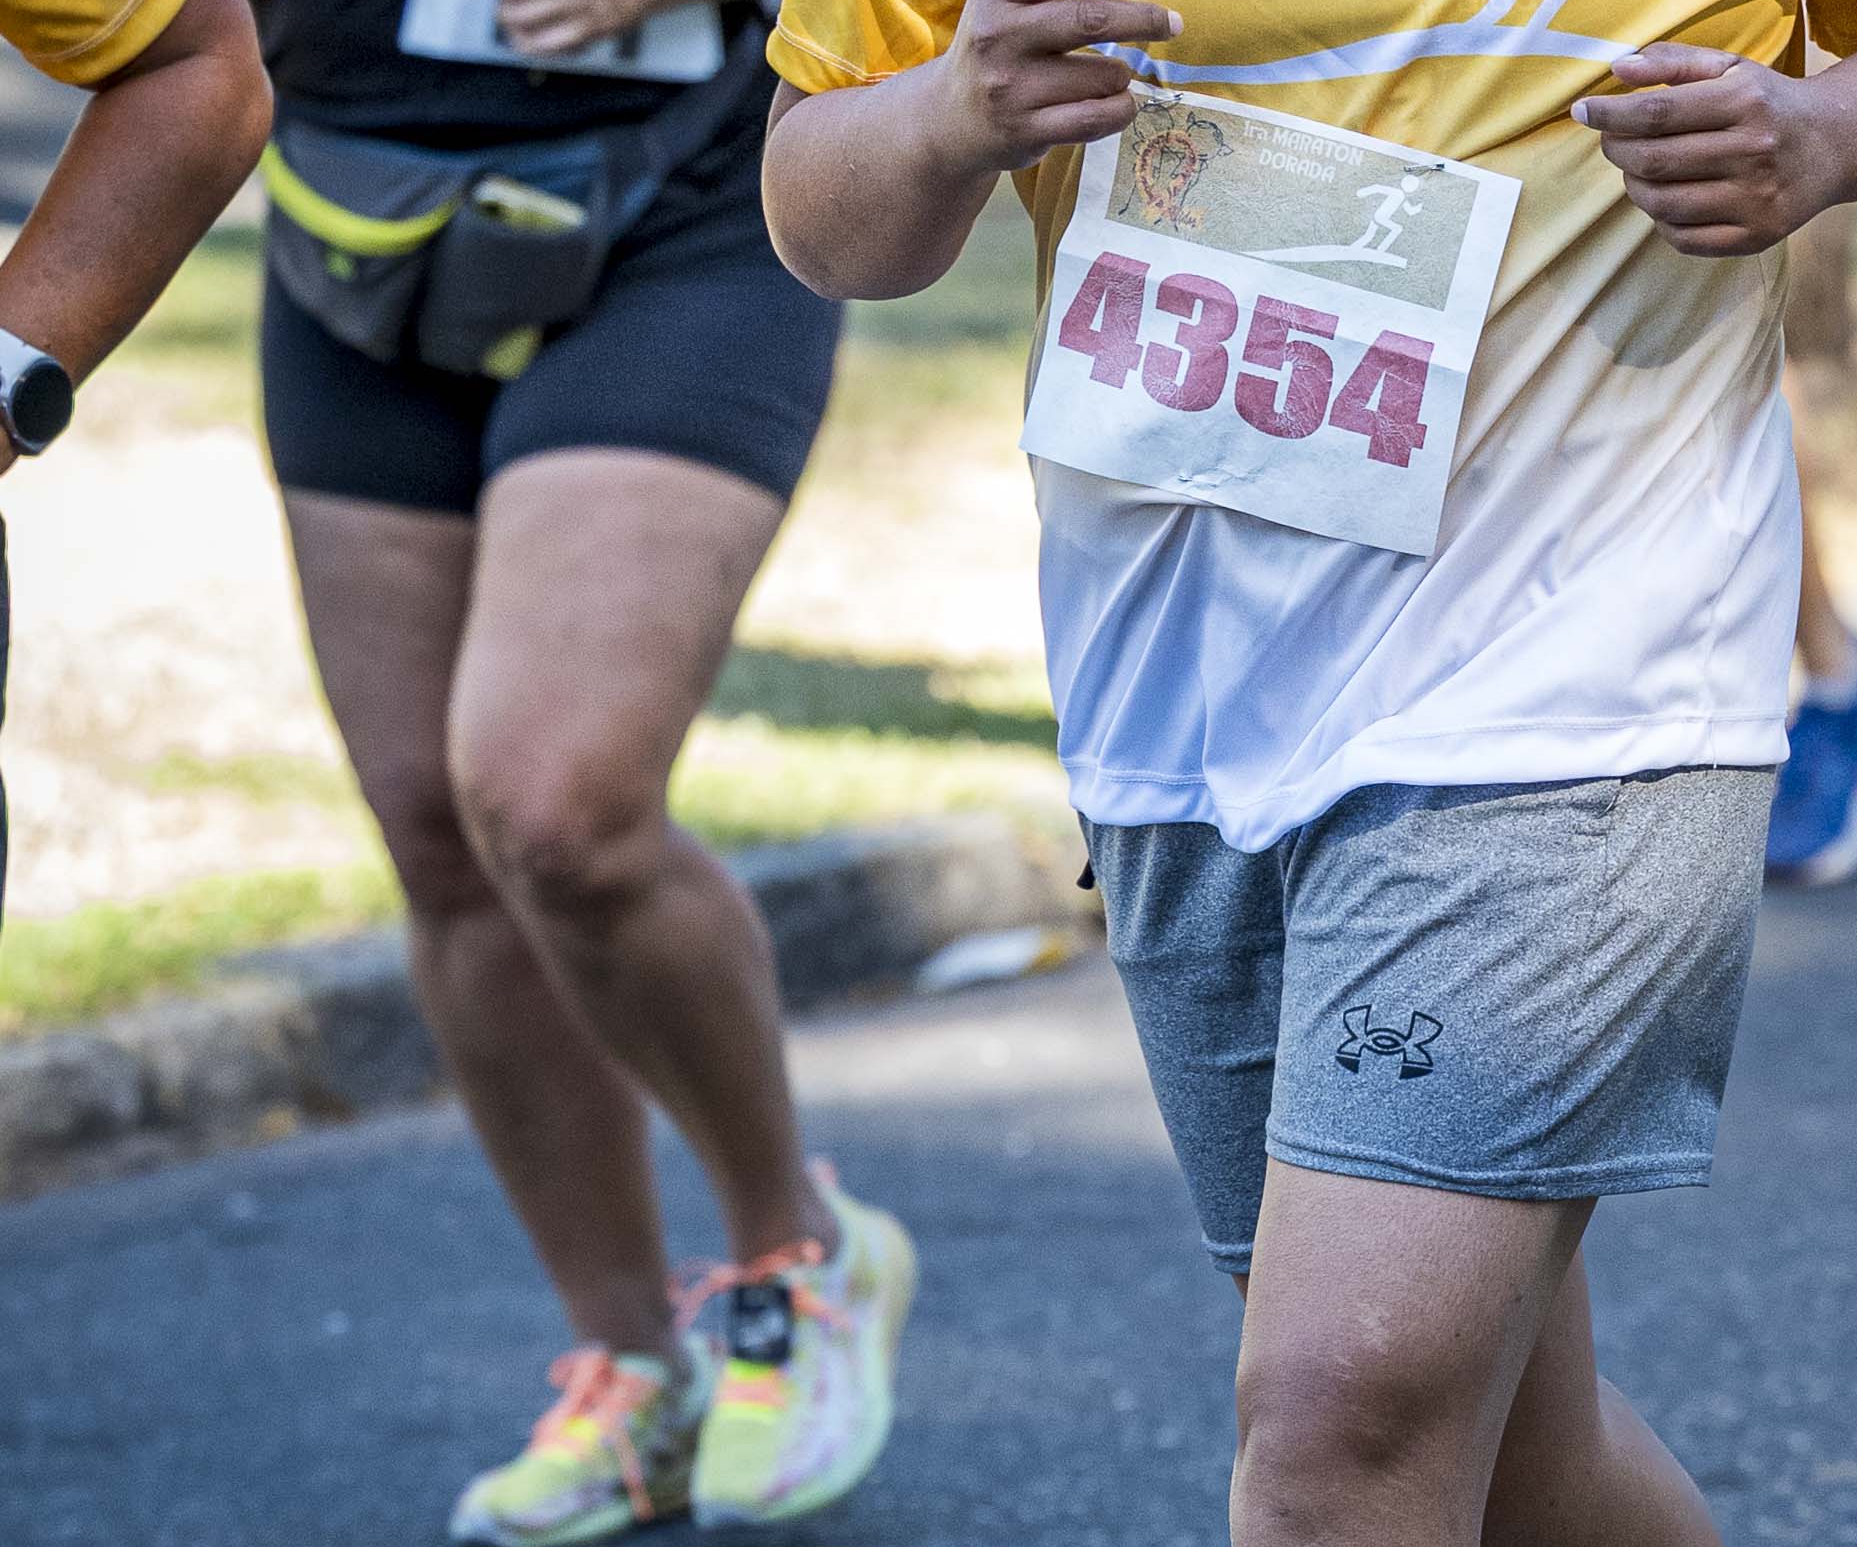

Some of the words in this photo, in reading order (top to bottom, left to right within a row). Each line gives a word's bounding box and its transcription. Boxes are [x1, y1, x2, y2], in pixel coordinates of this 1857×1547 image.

[1258, 148, 1338, 183] DORADA
[1271, 126, 1365, 166] MARATON
[1057, 250, 1435, 468] 4354
